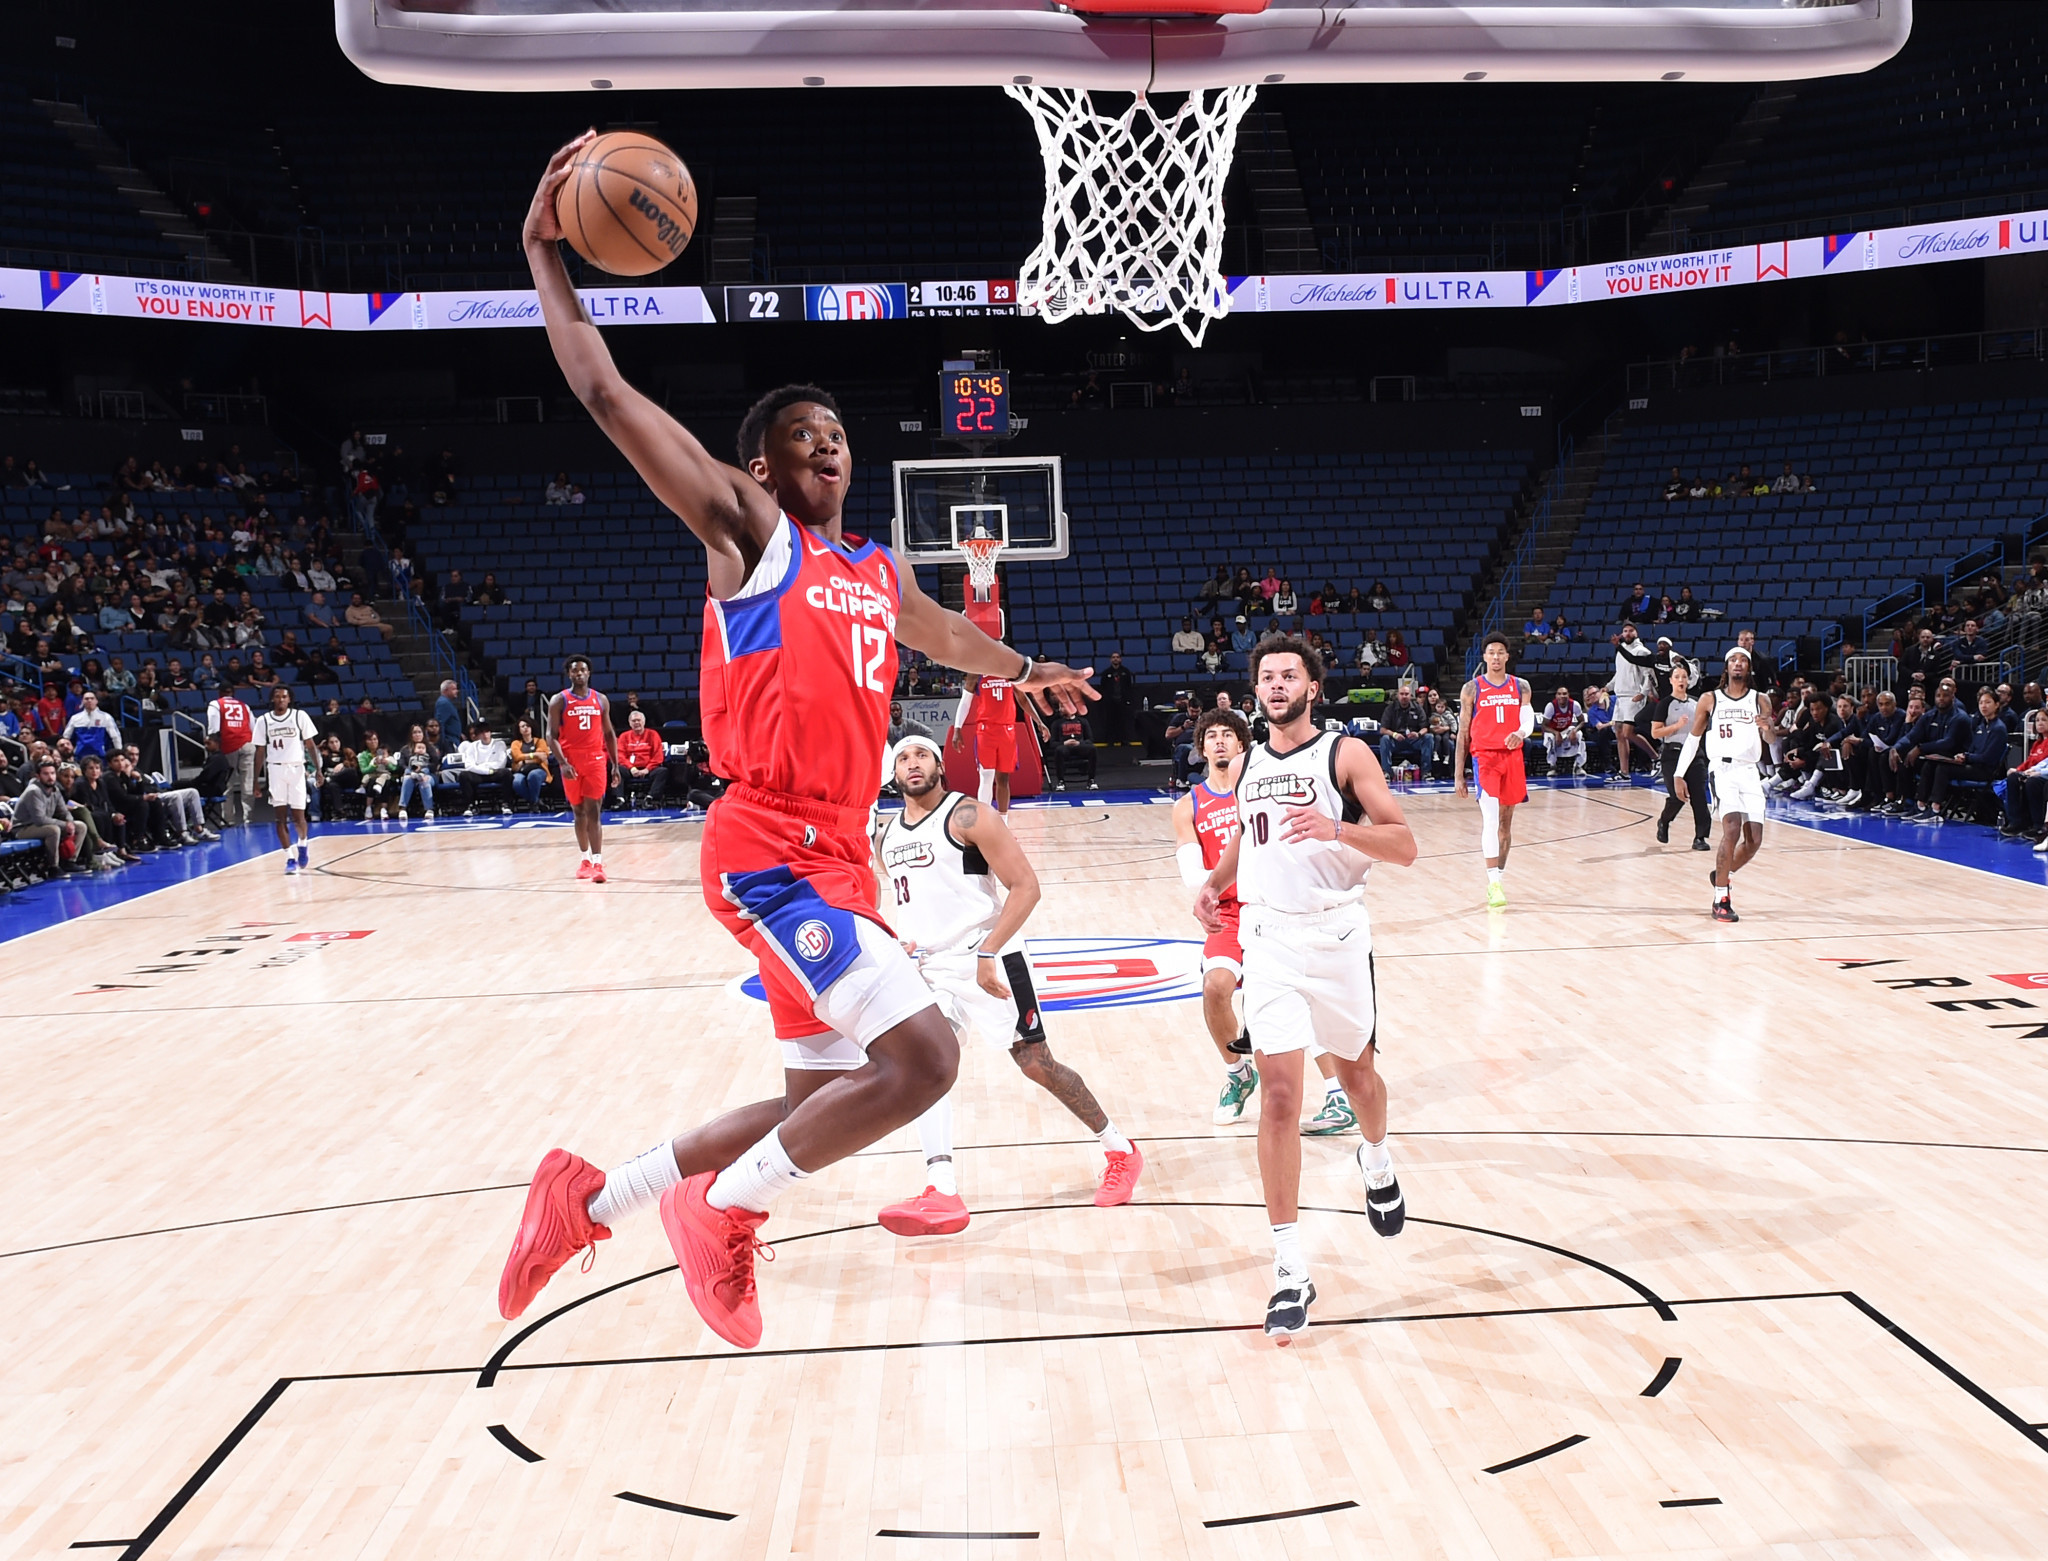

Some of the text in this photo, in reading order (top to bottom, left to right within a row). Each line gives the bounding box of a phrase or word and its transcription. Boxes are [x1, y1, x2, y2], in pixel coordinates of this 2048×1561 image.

[1899, 227, 1992, 258] Michelob
[1605, 252, 1732, 277] IT'S ONLY WORTH IT IF
[1607, 266, 1731, 294] YOU ENJOY IT
[135, 281, 275, 303] IT'S ONLY WORTH IT IF
[910, 285, 1009, 302] 2 10:46 23
[1290, 281, 1491, 304] Michelob ULTRA
[137, 296, 275, 322] YOU ENJOY IT
[448, 296, 661, 321] Michelob LTRA
[748, 291, 780, 318] 22
[954, 377, 1003, 396] 10:46
[956, 398, 995, 431] 22
[904, 423, 919, 431] 109
[806, 585, 896, 638] CLIPPER
[851, 623, 887, 693] 12
[992, 688, 1003, 701] 41
[1480, 698, 1520, 707] CLIPPERS
[224, 703, 243, 720] 23
[568, 709, 600, 717] CLIPPERS
[1495, 706, 1504, 723] 11
[579, 715, 591, 730] 21
[1719, 723, 1732, 739] 55
[273, 739, 284, 750] 44
[1207, 805, 1237, 819] ONTAR
[1197, 813, 1238, 833] CLIPP
[1249, 812, 1268, 847] 10
